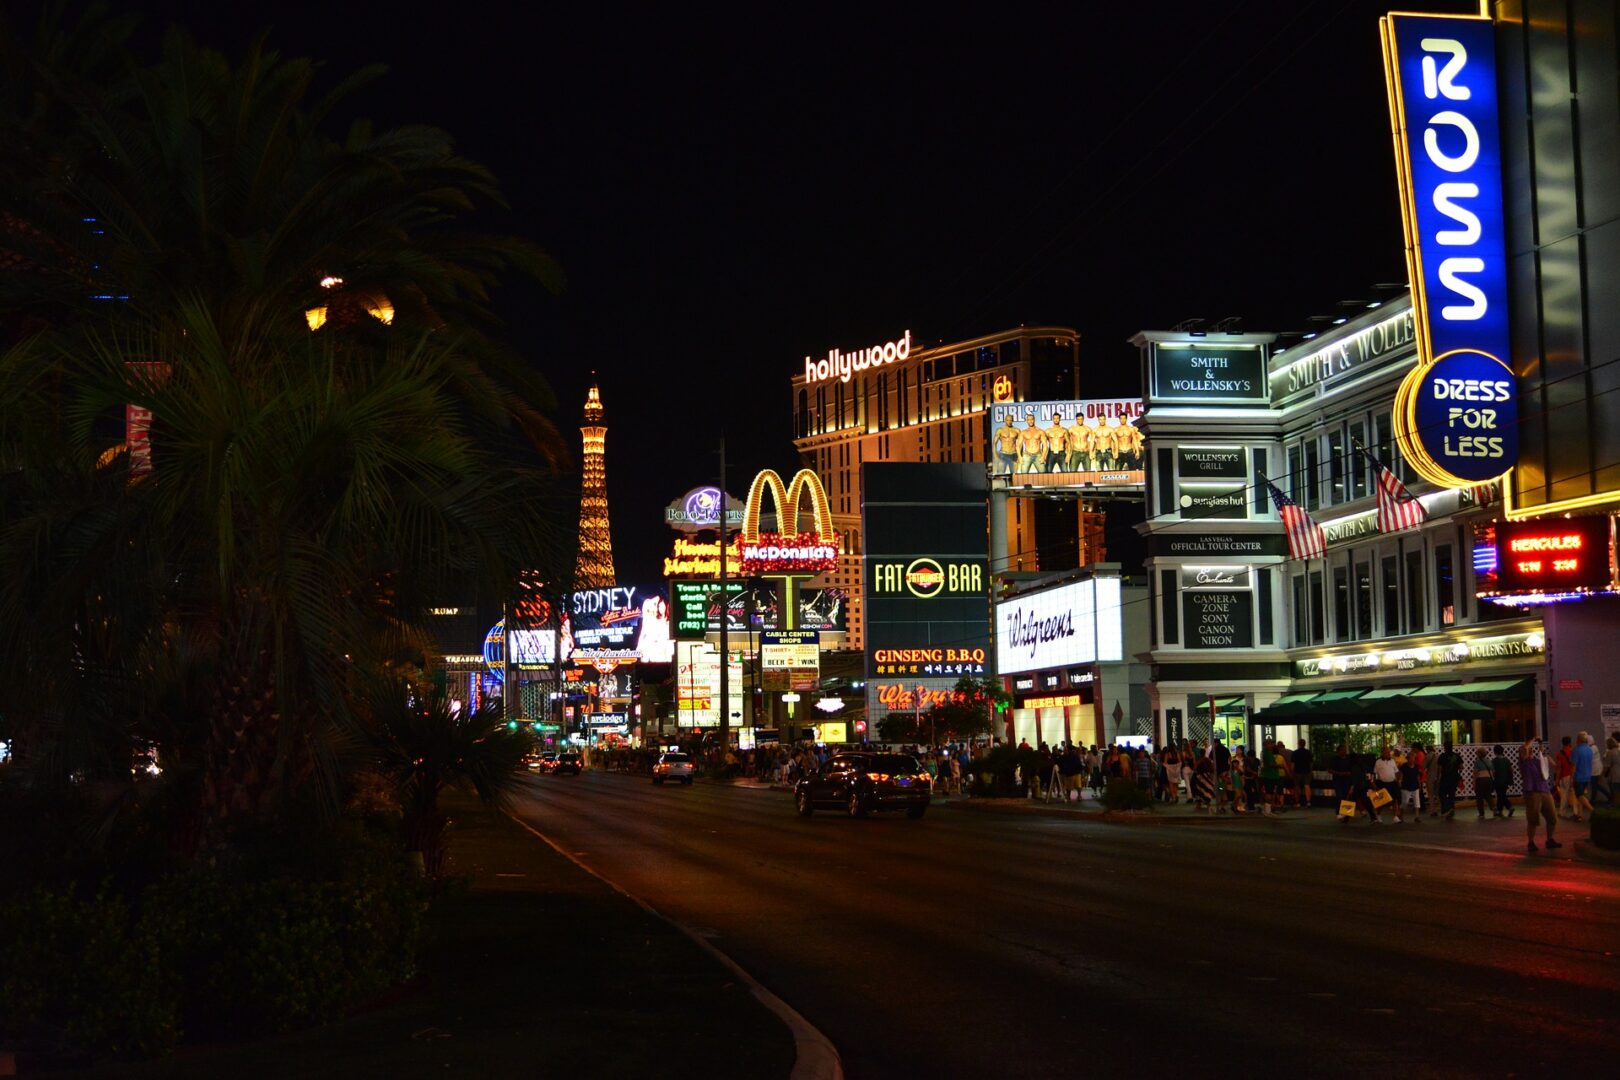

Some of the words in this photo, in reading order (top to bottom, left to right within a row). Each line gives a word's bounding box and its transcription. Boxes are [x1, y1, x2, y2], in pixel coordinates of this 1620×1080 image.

[1420, 37, 1488, 321] ROSS
[805, 330, 911, 383] hollywood
[1288, 350, 1334, 393] SMITH
[1339, 344, 1351, 370] &
[1356, 312, 1417, 362] WOLLE
[1190, 357, 1228, 368] SMITH
[1205, 368, 1215, 380] &
[1170, 379, 1251, 391] WOLLENSKY'S
[1433, 378, 1510, 402] DRESS
[993, 404, 1039, 423] GIRLS'
[1040, 402, 1083, 422] NIGHT
[1086, 401, 1144, 419] OUTBAC
[1448, 407, 1497, 430] FOR
[1443, 435, 1504, 458] LESS
[1184, 453, 1239, 462] WOLLENSKY'S
[1200, 462, 1224, 470] GRILL
[1229, 495, 1244, 506] hut
[1170, 542, 1207, 551] OFFICIAL
[1207, 542, 1230, 550] TOUR
[1230, 541, 1262, 550] CENTER
[1511, 535, 1581, 552] HERCULES
[744, 546, 835, 560] McDonald's
[875, 563, 904, 592] FAT
[948, 563, 982, 592] BAR
[573, 586, 636, 614] SYDNEY
[1193, 595, 1238, 604] CAMERA
[1202, 603, 1230, 613] ZONE
[1202, 614, 1230, 623] SONY
[1006, 606, 1075, 659] Walgreens
[1198, 625, 1235, 634] CANON
[1201, 636, 1232, 645] NIKON
[874, 649, 942, 662] GINSENG
[946, 648, 985, 663] B.B.Q
[585, 713, 623, 724] Tavelodge
